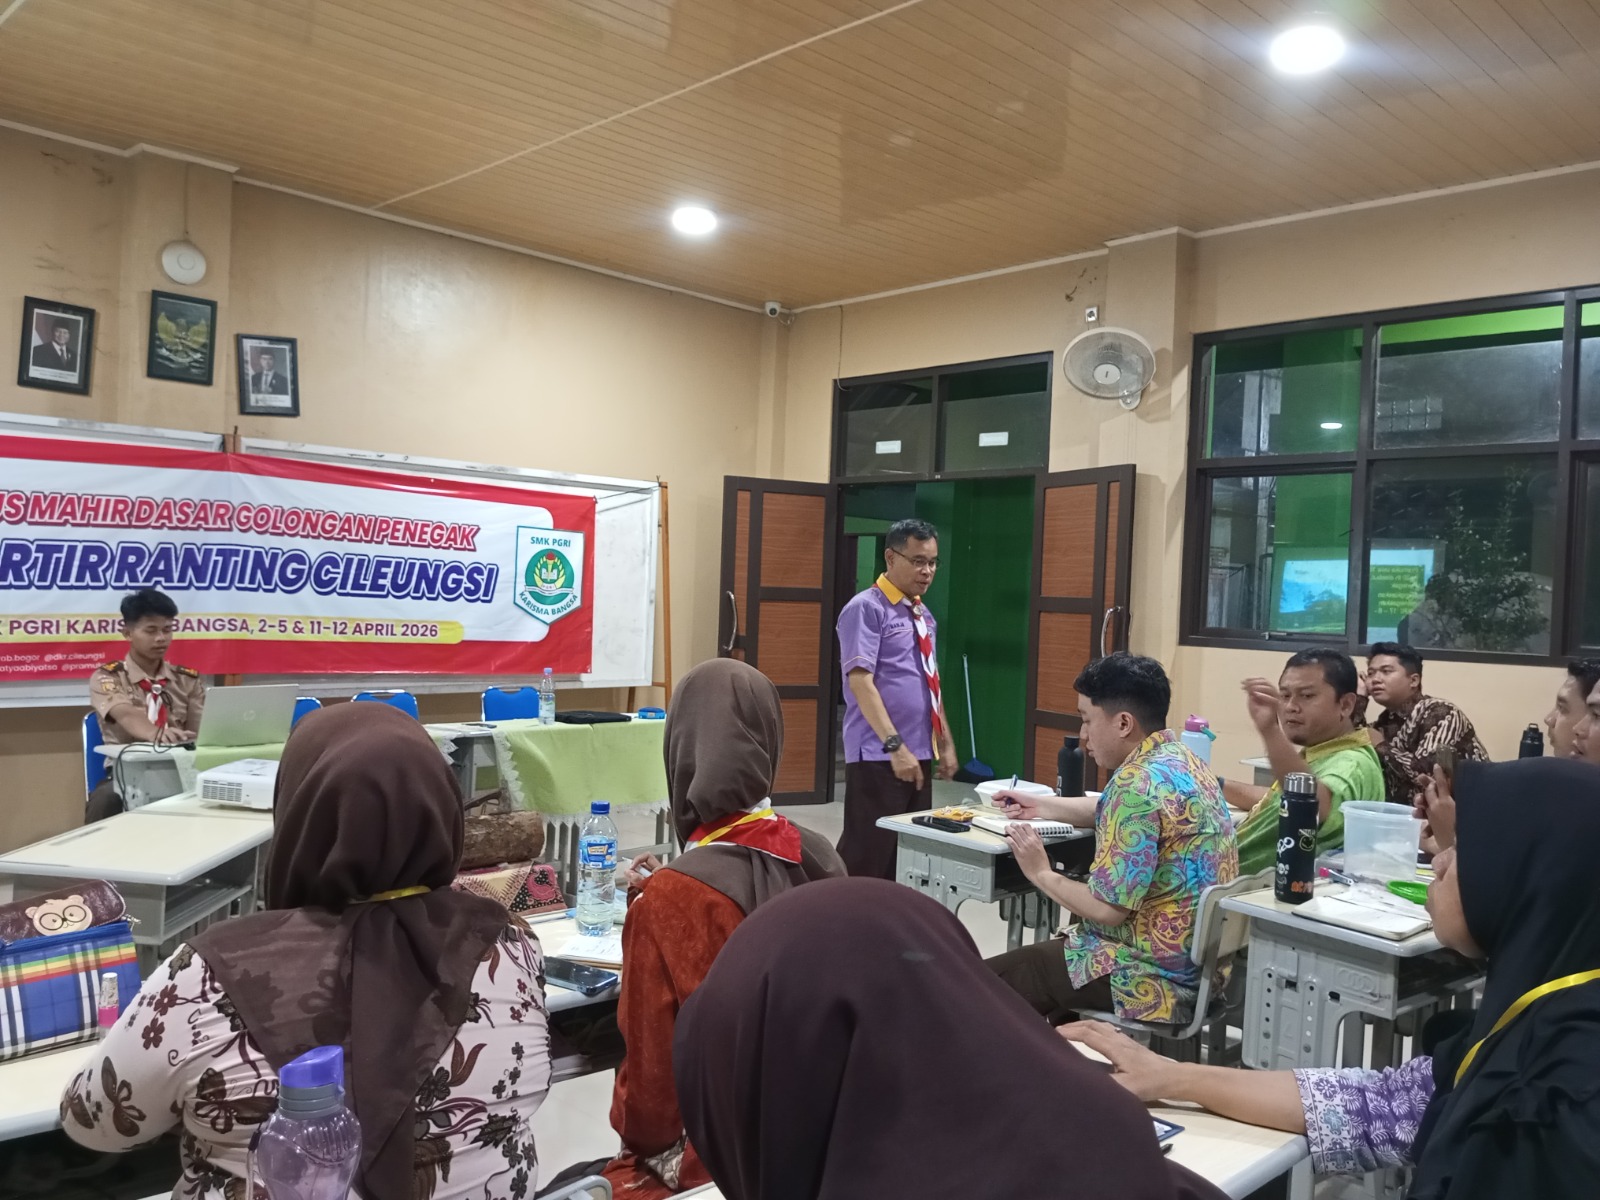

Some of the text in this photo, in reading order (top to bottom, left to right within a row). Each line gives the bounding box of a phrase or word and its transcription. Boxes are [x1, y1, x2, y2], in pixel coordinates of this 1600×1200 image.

[0, 490, 480, 551] S MAHIR DASAR GOLONGAN PENEGAK
[530, 536, 571, 547] SMK PGRI
[111, 541, 311, 594] RANTING
[311, 552, 499, 603] CILEUNGSI
[519, 591, 578, 616] KARISMA BANGSA
[9, 619, 61, 635] PGRI
[66, 619, 127, 634] KARIS
[292, 620, 305, 634] &
[352, 622, 397, 637] APRIL
[401, 624, 438, 637] 2026
